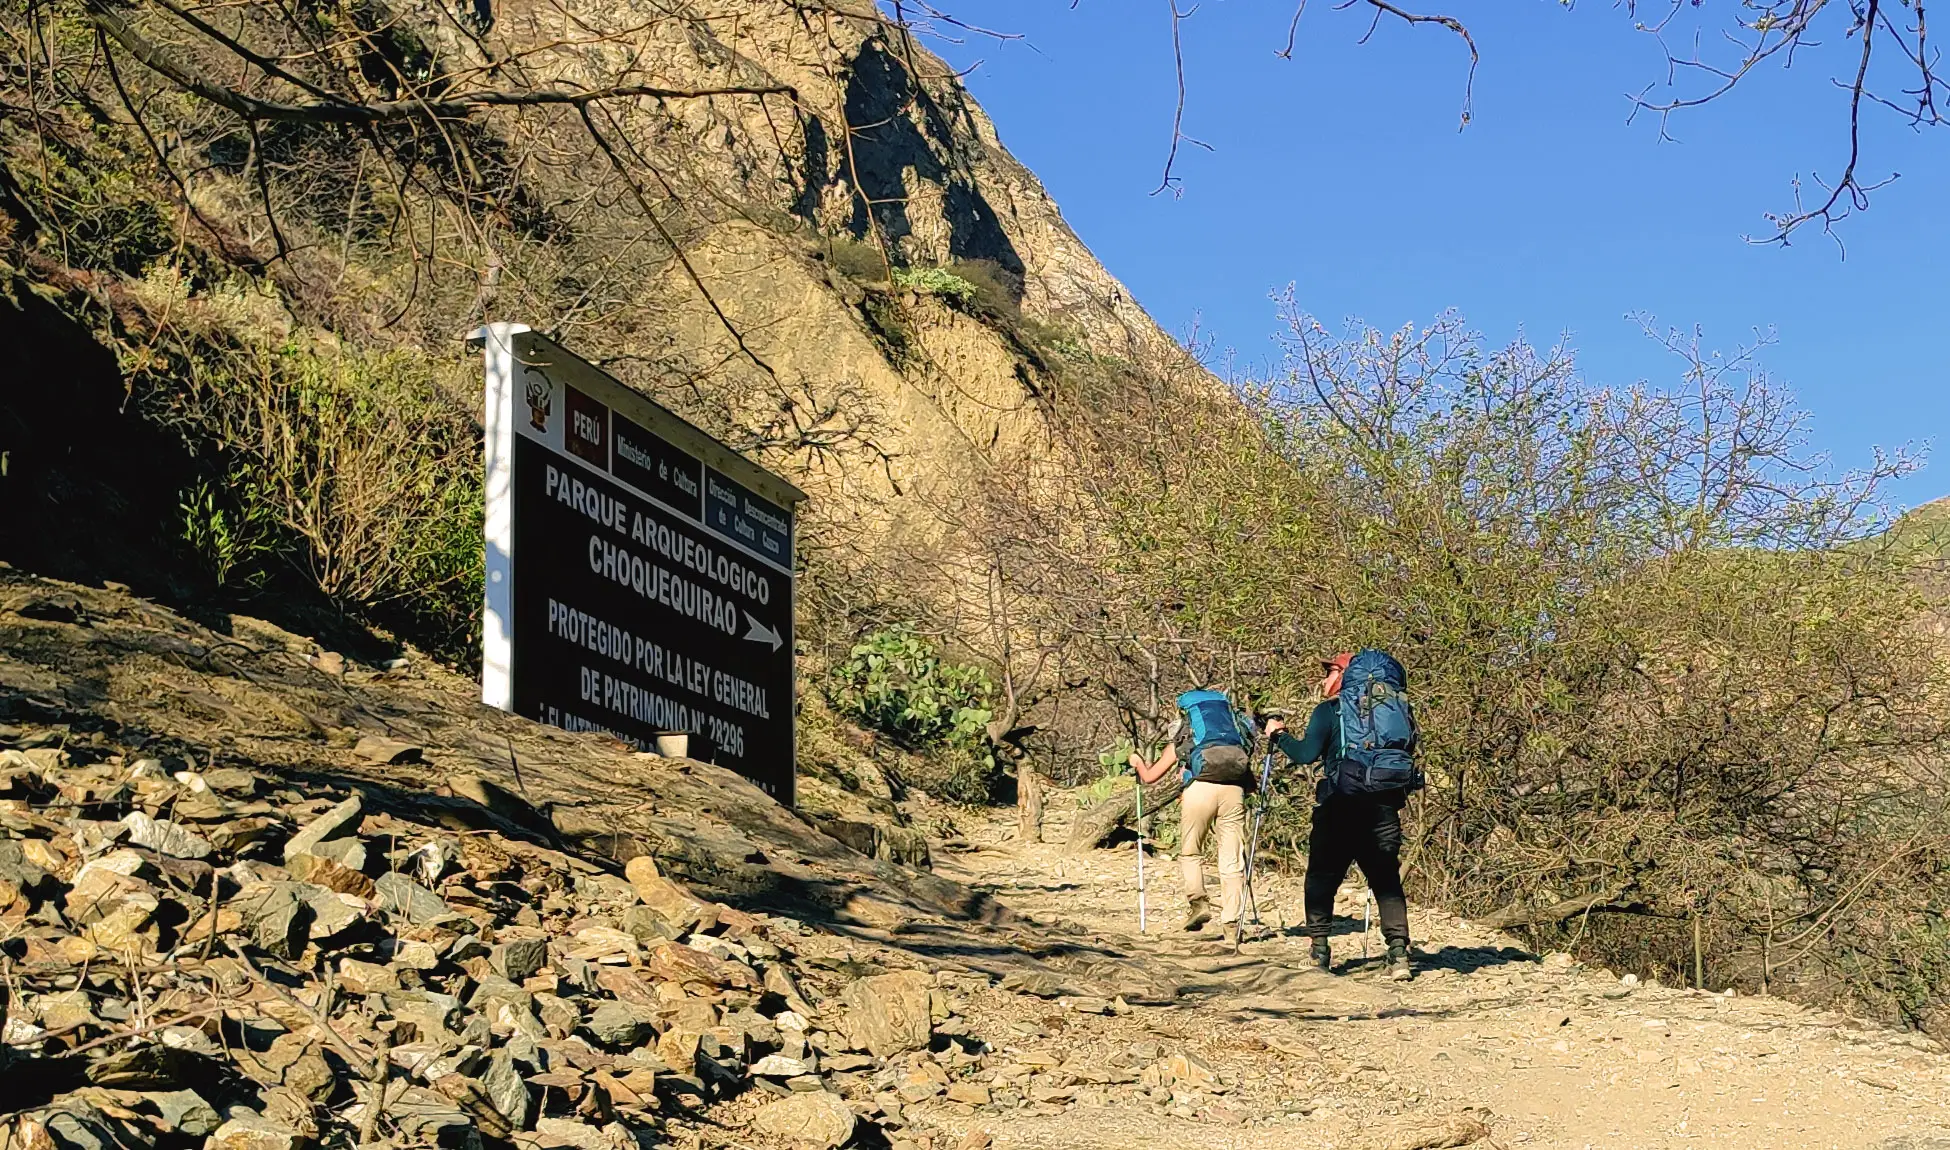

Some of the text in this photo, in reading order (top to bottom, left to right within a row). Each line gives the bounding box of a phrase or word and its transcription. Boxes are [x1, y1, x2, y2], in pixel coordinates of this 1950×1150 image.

[574, 410, 600, 445] PERÚ
[617, 434, 697, 498] Ministerio de Cultura
[545, 464, 770, 606] PARQUE ARQUEOLOGICO
[718, 507, 727, 526] de
[734, 514, 755, 541] Cultura
[588, 534, 737, 636] CHOQUEQUIRAO
[549, 597, 770, 720] PROTEGIDO POR LA LEY GENERAL
[581, 665, 601, 706] DE
[604, 676, 689, 732] PATRIMONIO
[708, 715, 744, 758] 28296
